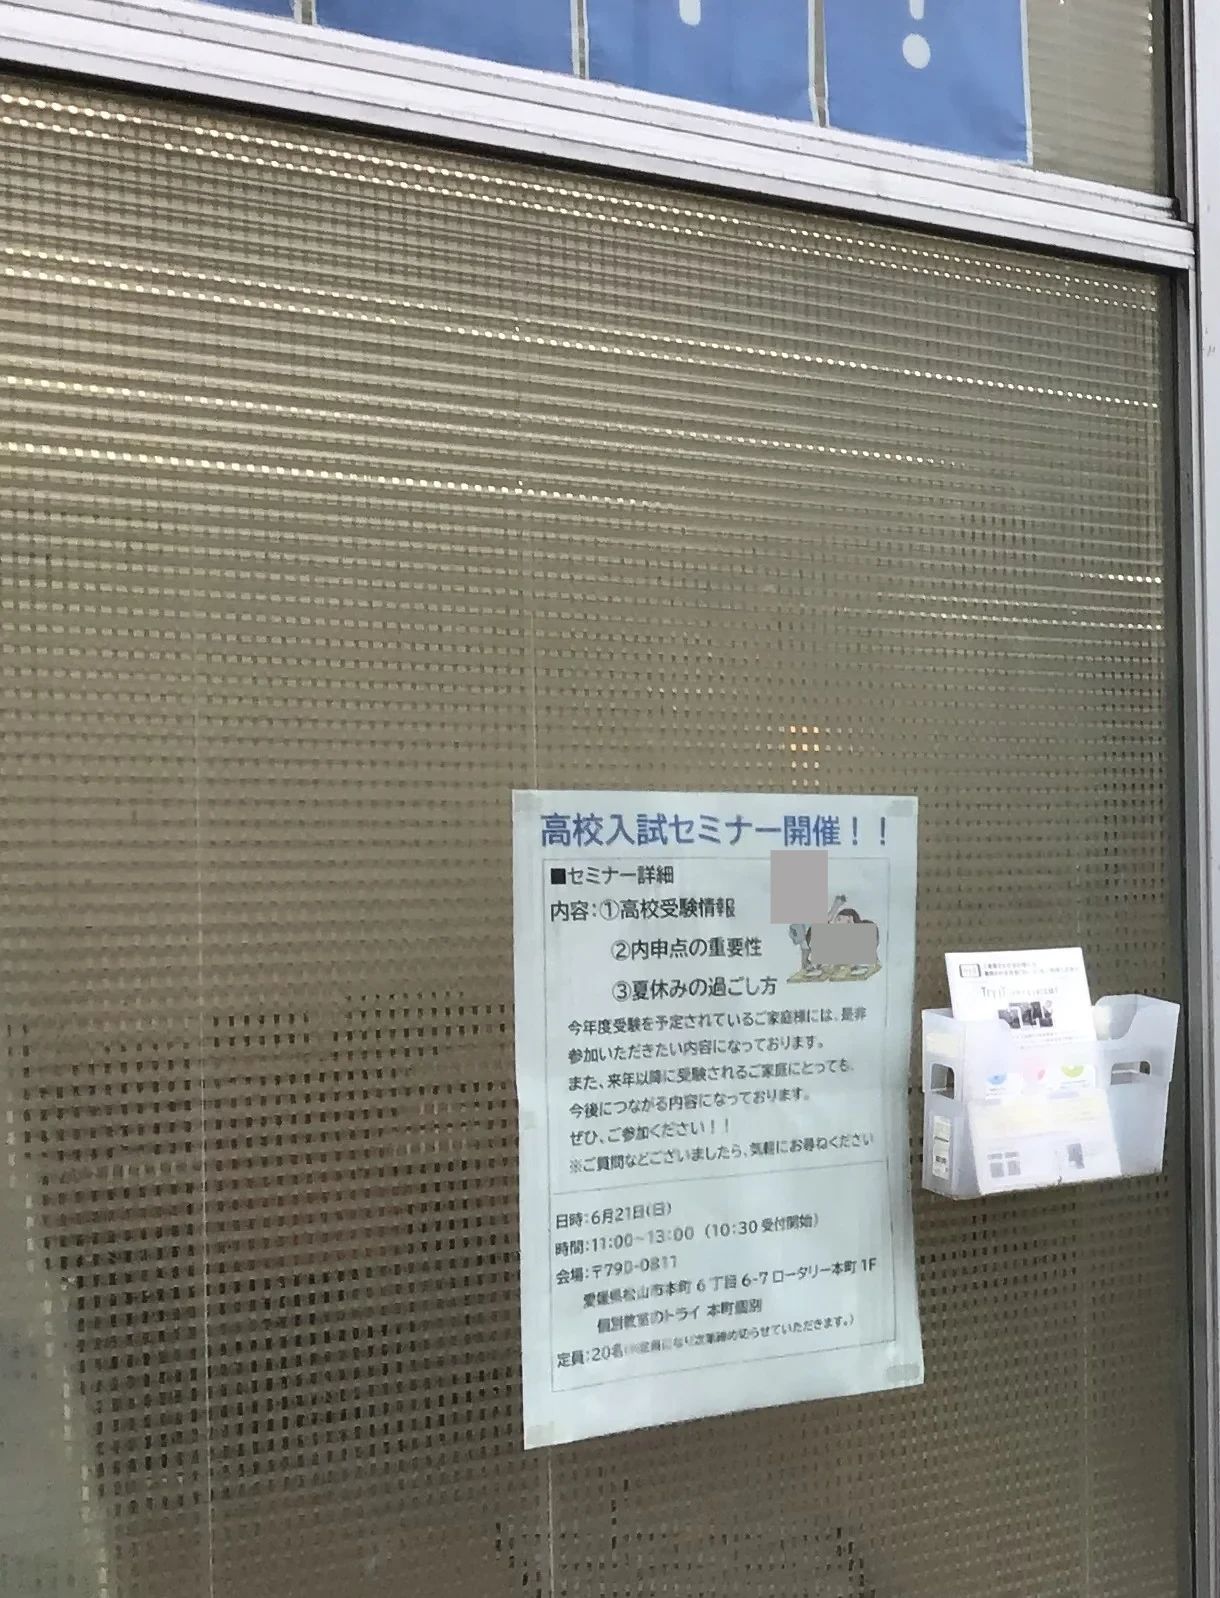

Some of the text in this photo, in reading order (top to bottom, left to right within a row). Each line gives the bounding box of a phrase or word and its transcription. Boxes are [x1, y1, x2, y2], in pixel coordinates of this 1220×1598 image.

[540, 812, 888, 847] 高校入試セミナー開催！！
